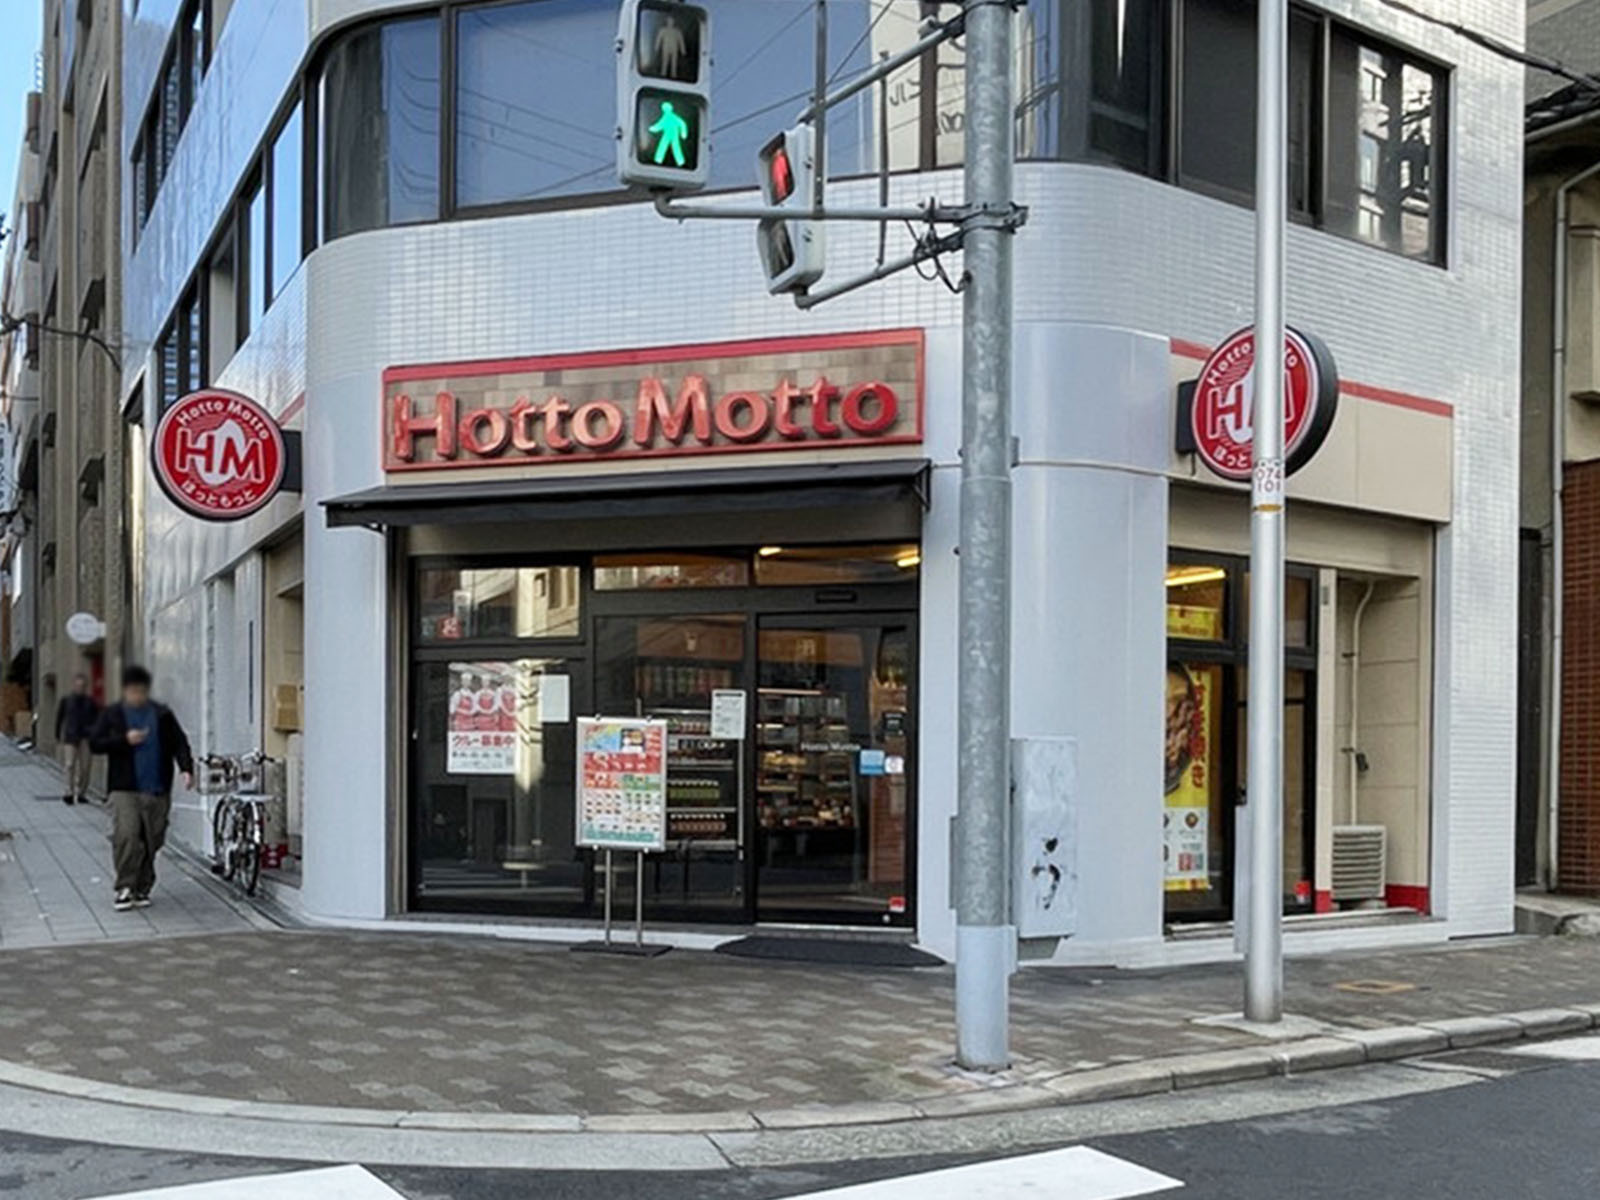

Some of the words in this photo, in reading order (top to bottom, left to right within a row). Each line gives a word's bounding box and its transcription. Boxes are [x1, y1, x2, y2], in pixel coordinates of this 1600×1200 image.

[1207, 342, 1251, 386] Hotto
[176, 401, 224, 426] Hotto
[227, 401, 269, 439] Motto
[394, 391, 623, 458] Hotto
[633, 373, 899, 445] Motto
[175, 427, 265, 483] HM
[181, 480, 256, 508] ほっともっと
